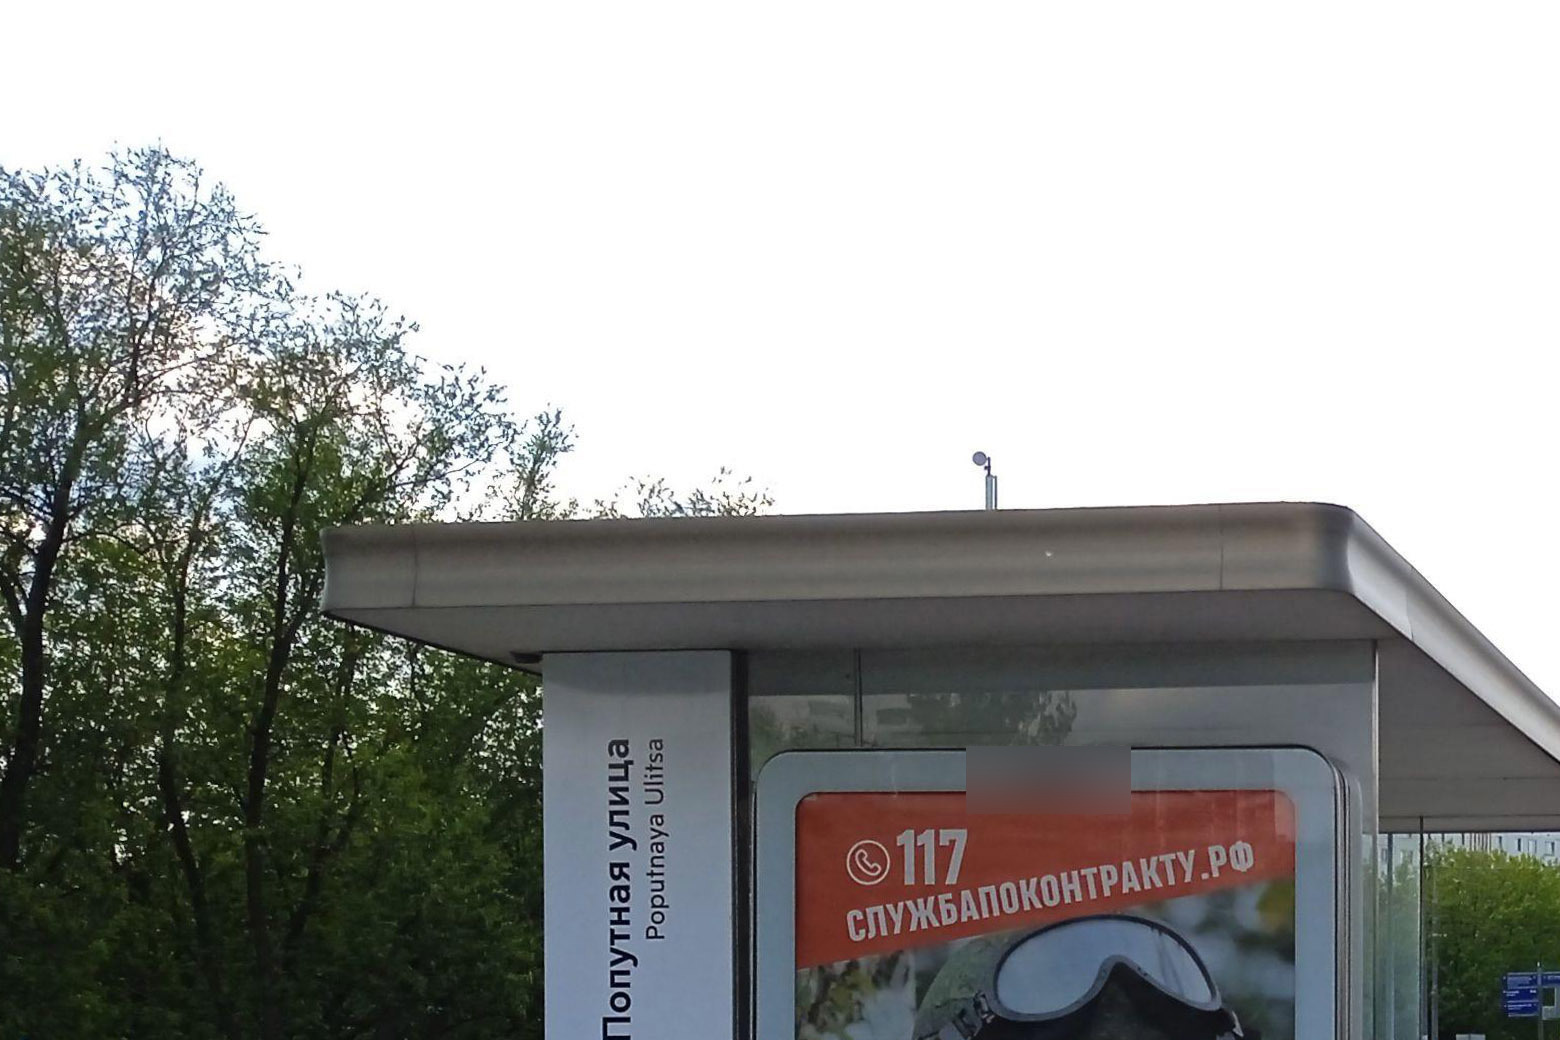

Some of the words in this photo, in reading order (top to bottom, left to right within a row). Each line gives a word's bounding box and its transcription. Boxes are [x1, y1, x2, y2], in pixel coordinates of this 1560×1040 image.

[608, 738, 638, 851] улица
[643, 738, 664, 805] Ulitsa
[646, 813, 670, 940] Poputnaya
[846, 840, 1256, 942] СЛУЖБАПОКОНТРАКТУ.РФ
[896, 828, 968, 887] 117
